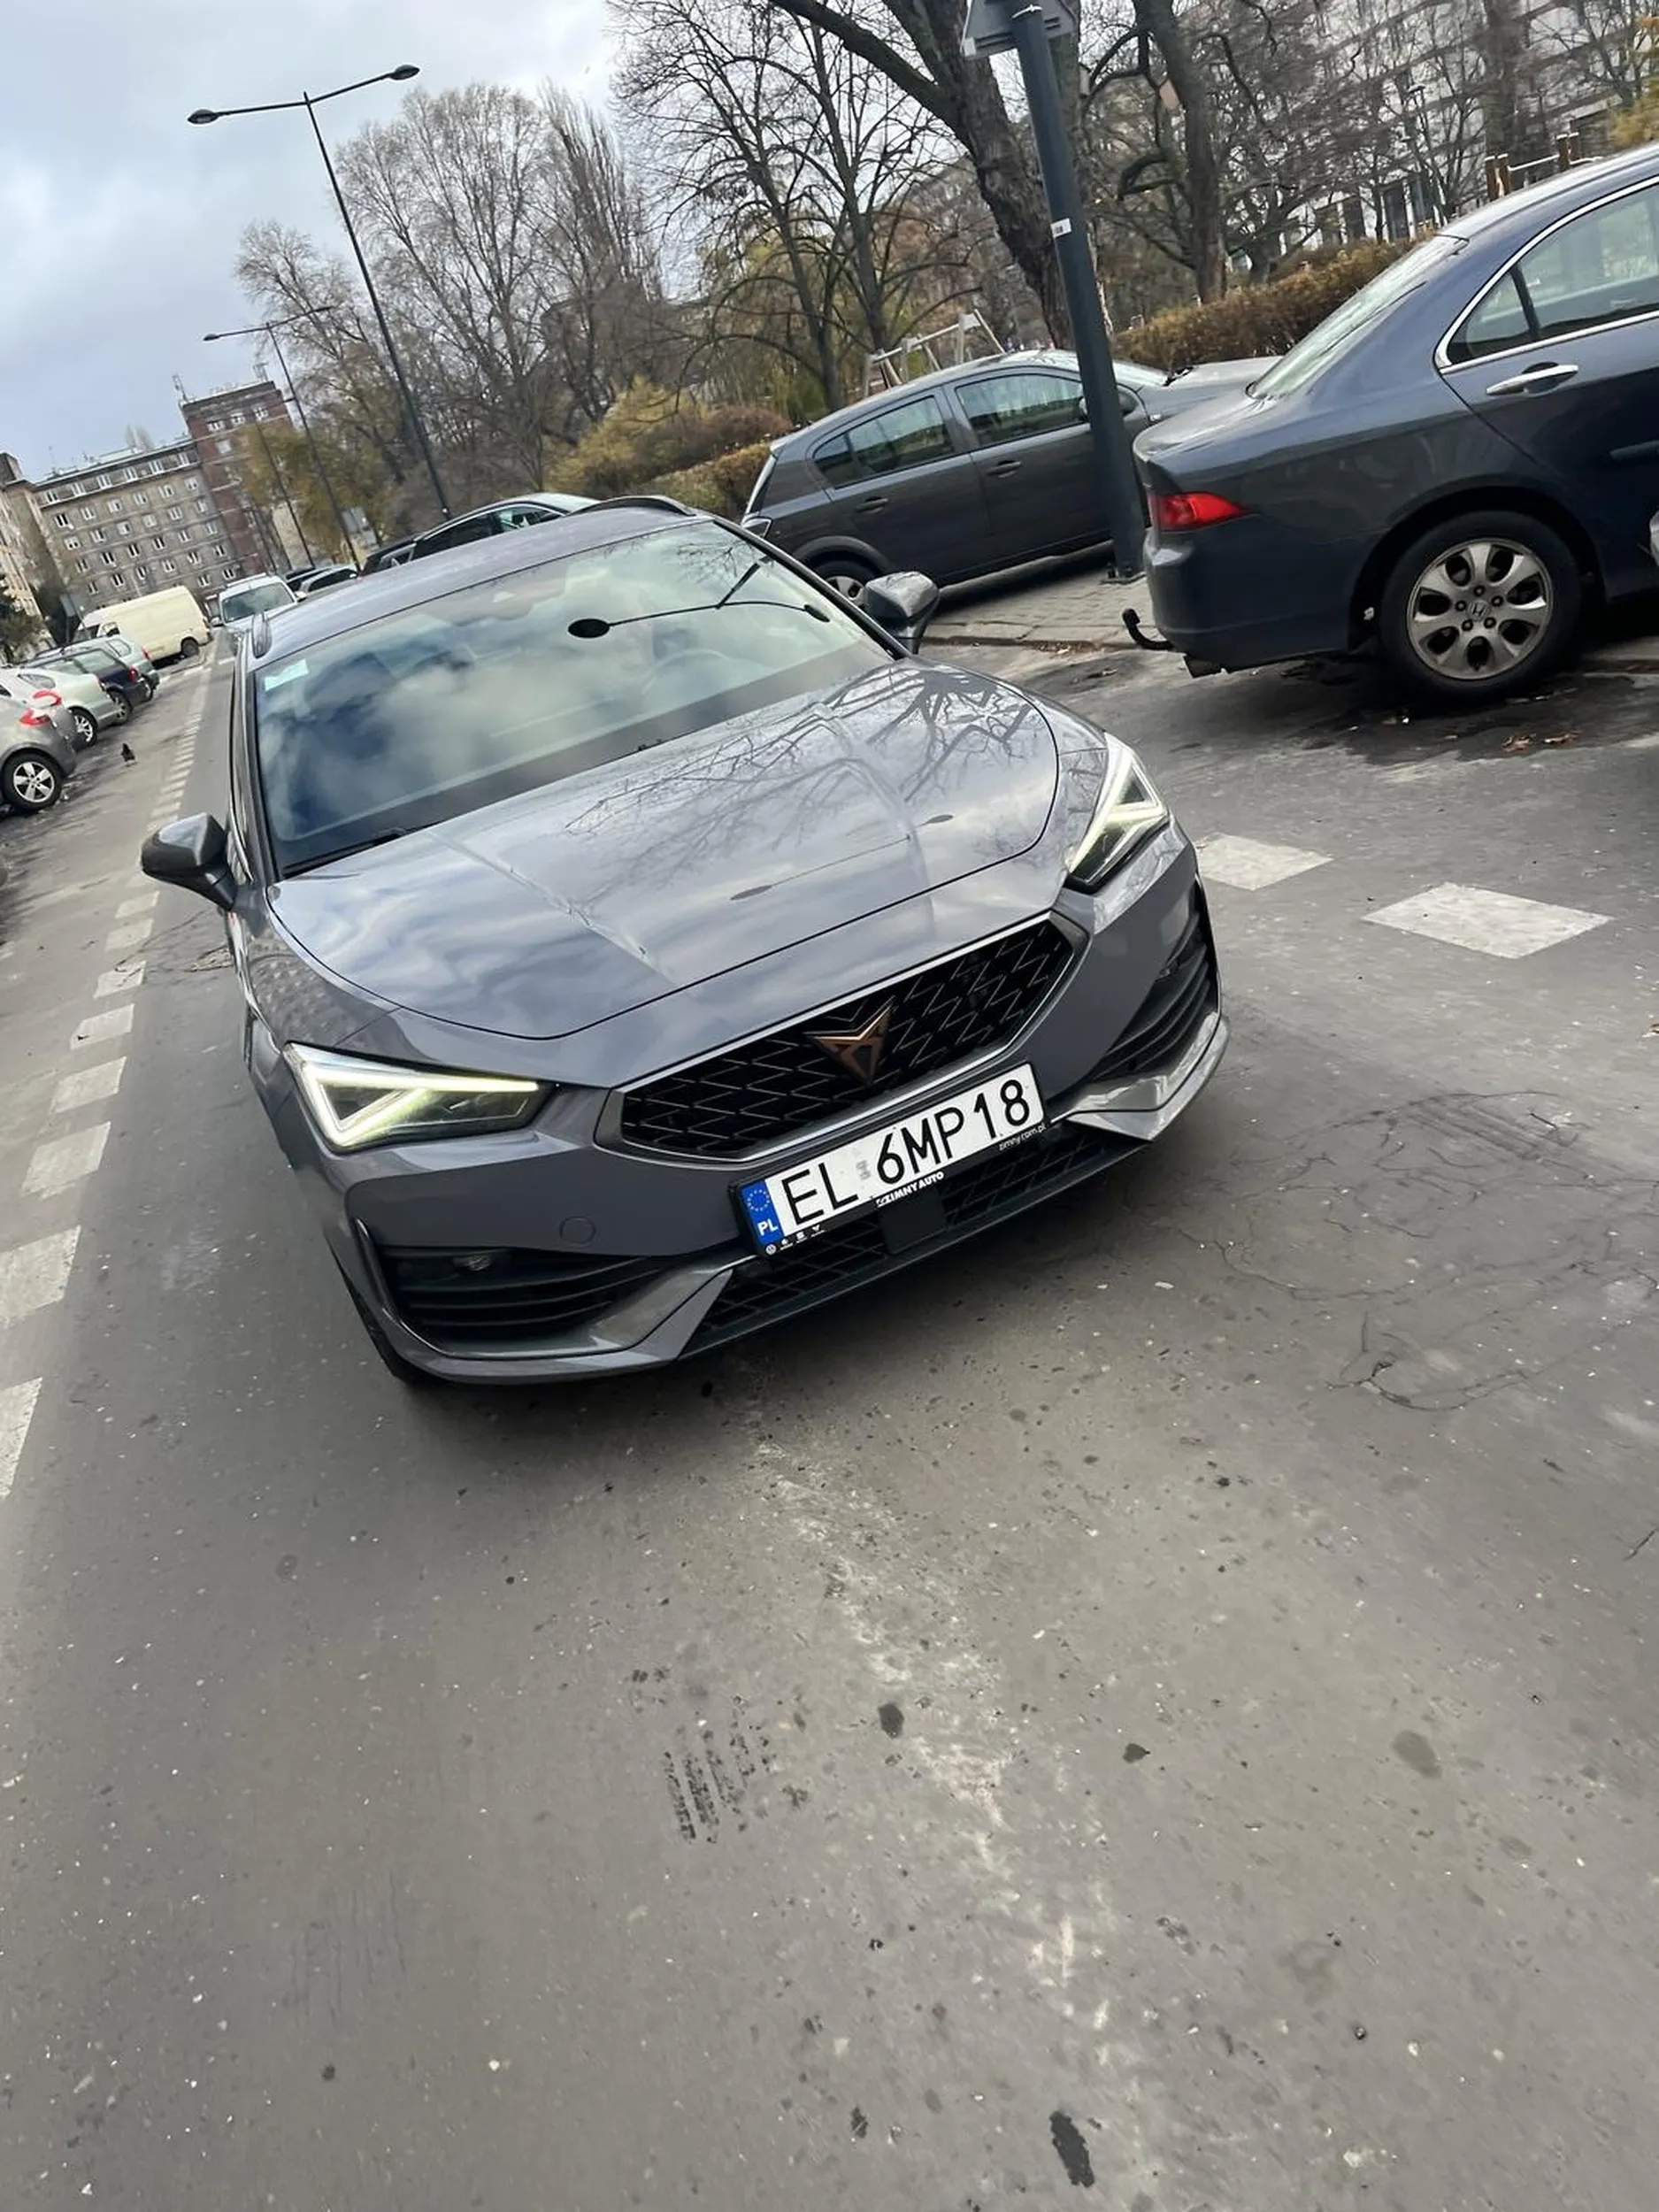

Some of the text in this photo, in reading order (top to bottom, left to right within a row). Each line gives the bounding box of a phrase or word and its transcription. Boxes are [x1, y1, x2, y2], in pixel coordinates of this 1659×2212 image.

[781, 1079, 1030, 1225] EL 6MP18
[757, 1218, 779, 1236] PL
